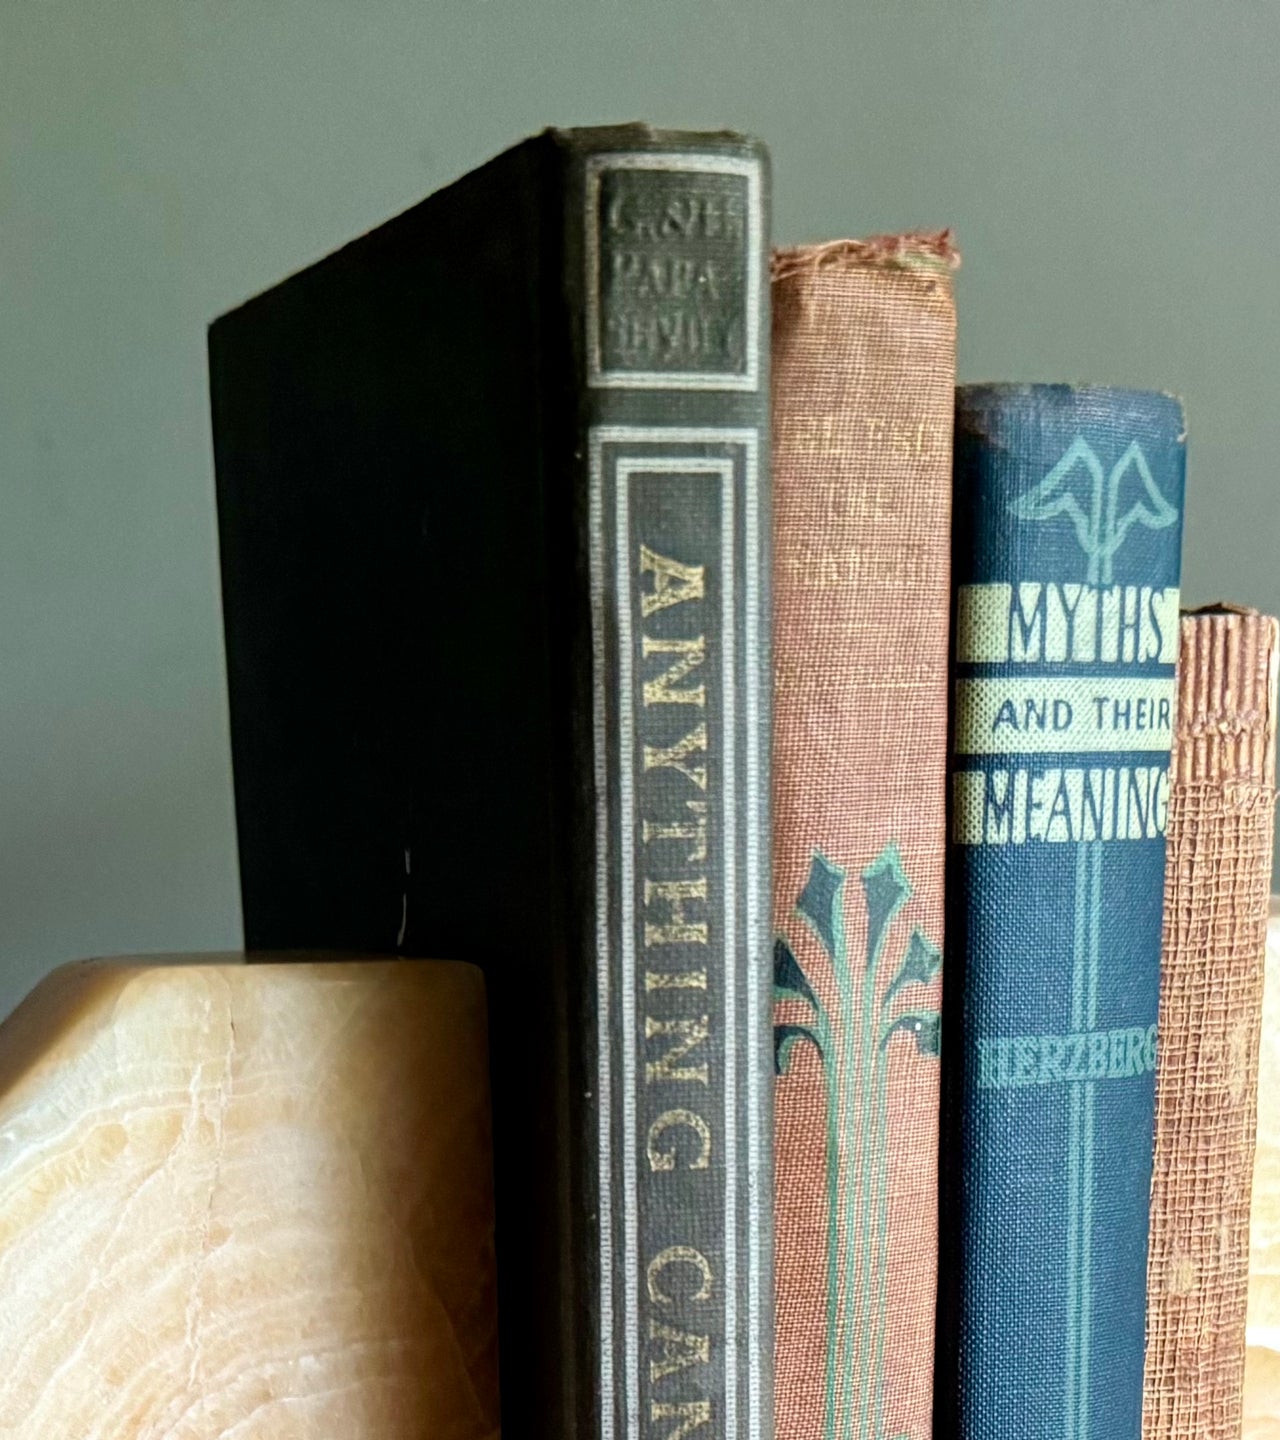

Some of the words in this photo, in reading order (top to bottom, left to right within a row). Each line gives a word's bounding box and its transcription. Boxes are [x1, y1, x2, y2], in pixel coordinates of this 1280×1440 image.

[1009, 582, 1163, 664] MYTHS
[992, 698, 1073, 732] AND
[1094, 697, 1170, 731] THEIR
[639, 544, 712, 1172] ANYTHING
